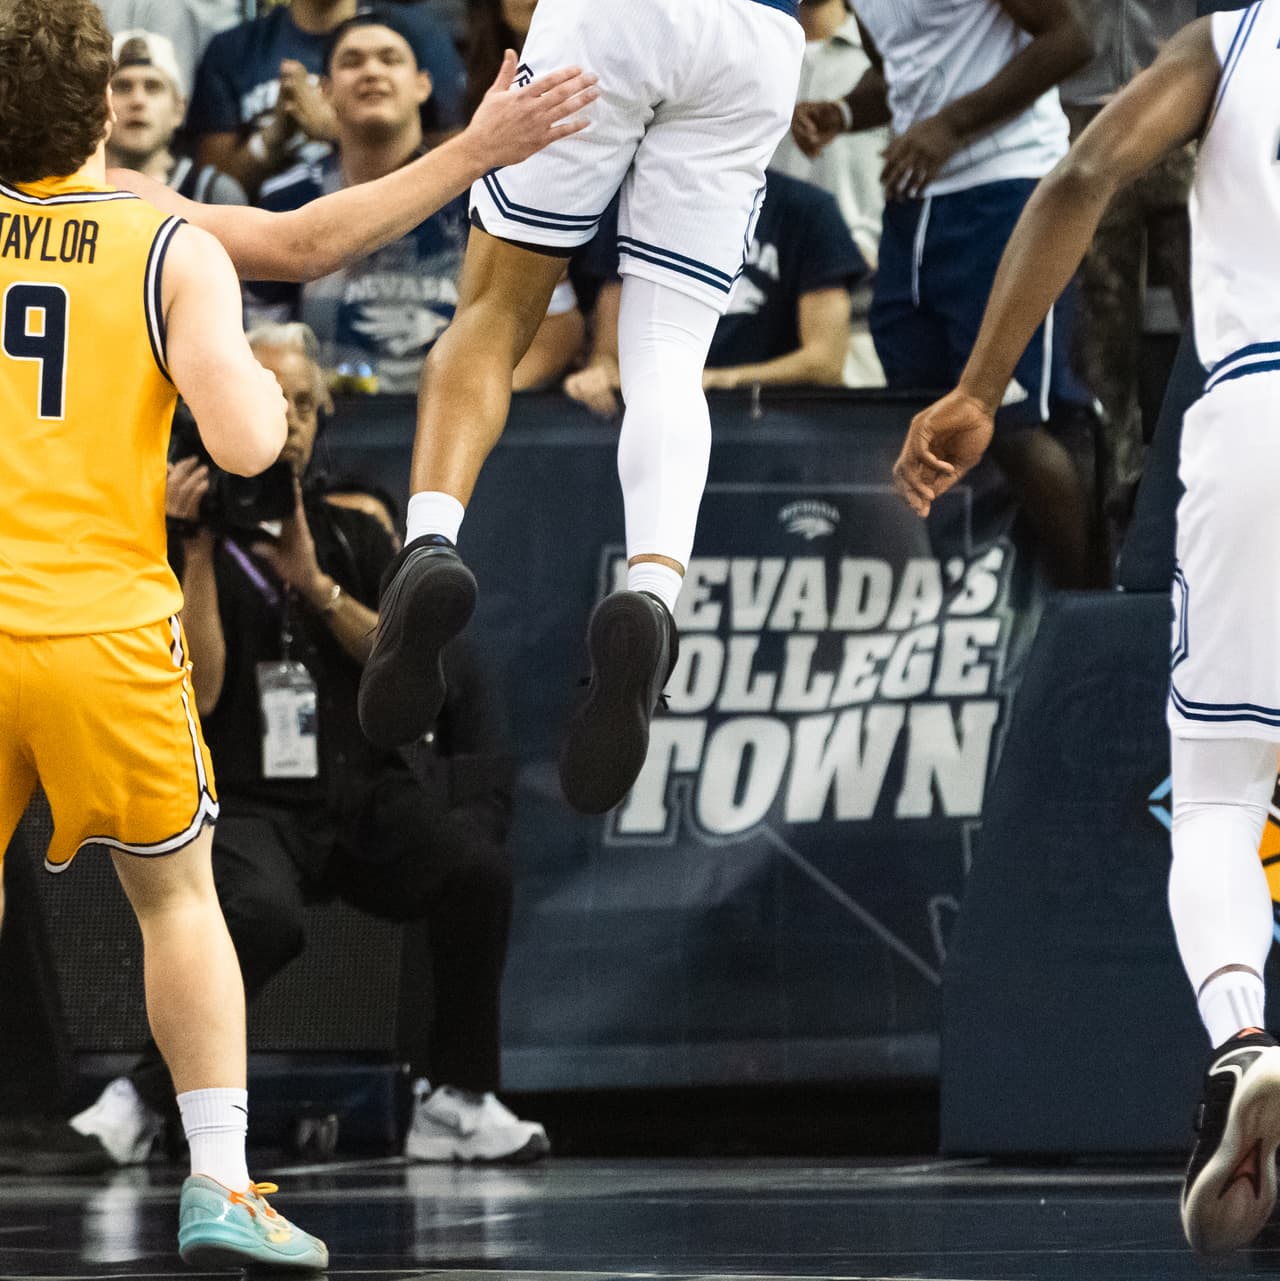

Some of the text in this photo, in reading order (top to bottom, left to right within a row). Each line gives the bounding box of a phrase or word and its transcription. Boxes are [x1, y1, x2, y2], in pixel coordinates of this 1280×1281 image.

[1, 281, 69, 420] 9
[613, 547, 1004, 632] EVADA'S
[666, 619, 1001, 714] OLLEGE
[617, 701, 1001, 835] TOWN
